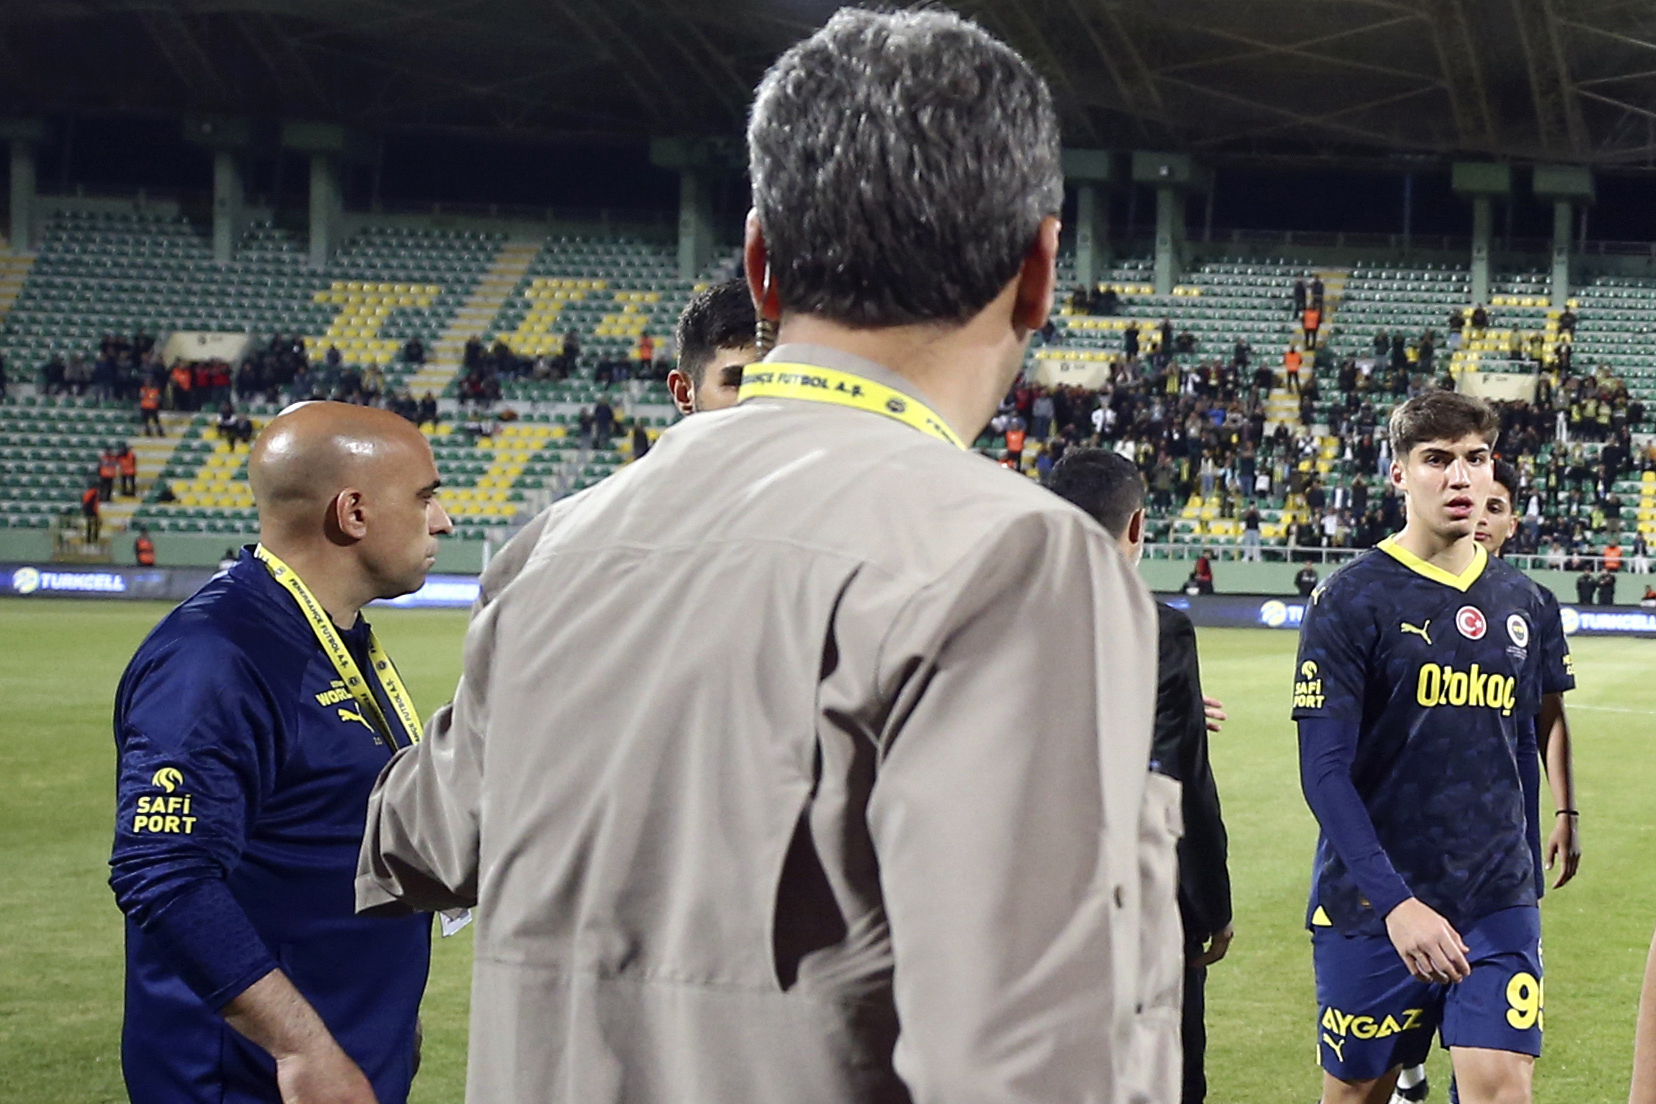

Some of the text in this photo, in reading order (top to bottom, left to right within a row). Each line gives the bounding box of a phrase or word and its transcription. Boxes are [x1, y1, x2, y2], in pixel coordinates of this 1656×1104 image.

[40, 572, 126, 592] TURKCELL
[132, 815, 198, 834] PORT
[1505, 972, 1544, 1033] 9
[1321, 1006, 1424, 1040] AYGAZ
